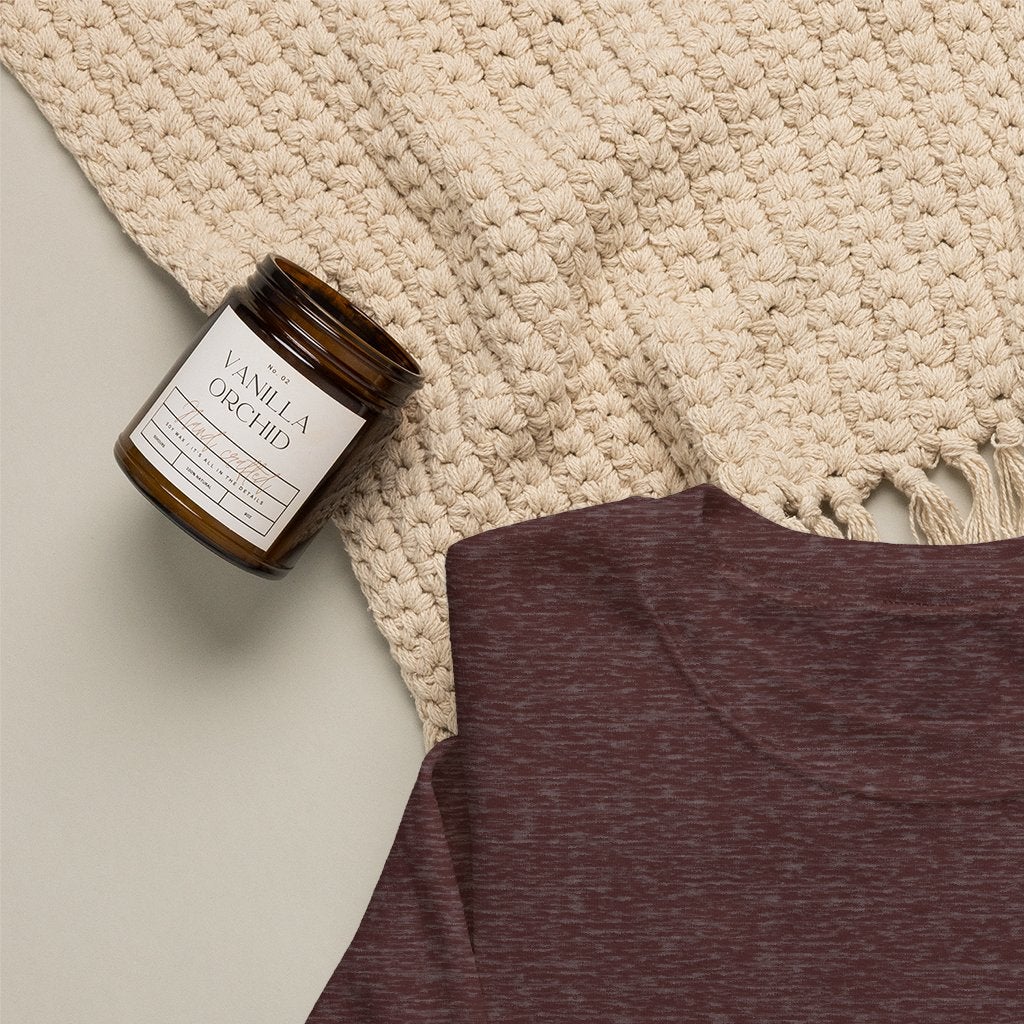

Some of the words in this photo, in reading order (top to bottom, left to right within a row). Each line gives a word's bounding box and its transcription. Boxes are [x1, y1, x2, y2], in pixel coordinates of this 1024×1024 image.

[224, 349, 309, 434] VANILLA
[280, 375, 291, 385] 02
[208, 377, 291, 450] ORCHID
[203, 458, 214, 469] ALL
[216, 468, 224, 476] IN
[225, 475, 237, 486] THE
[238, 485, 264, 505] DETAILS
